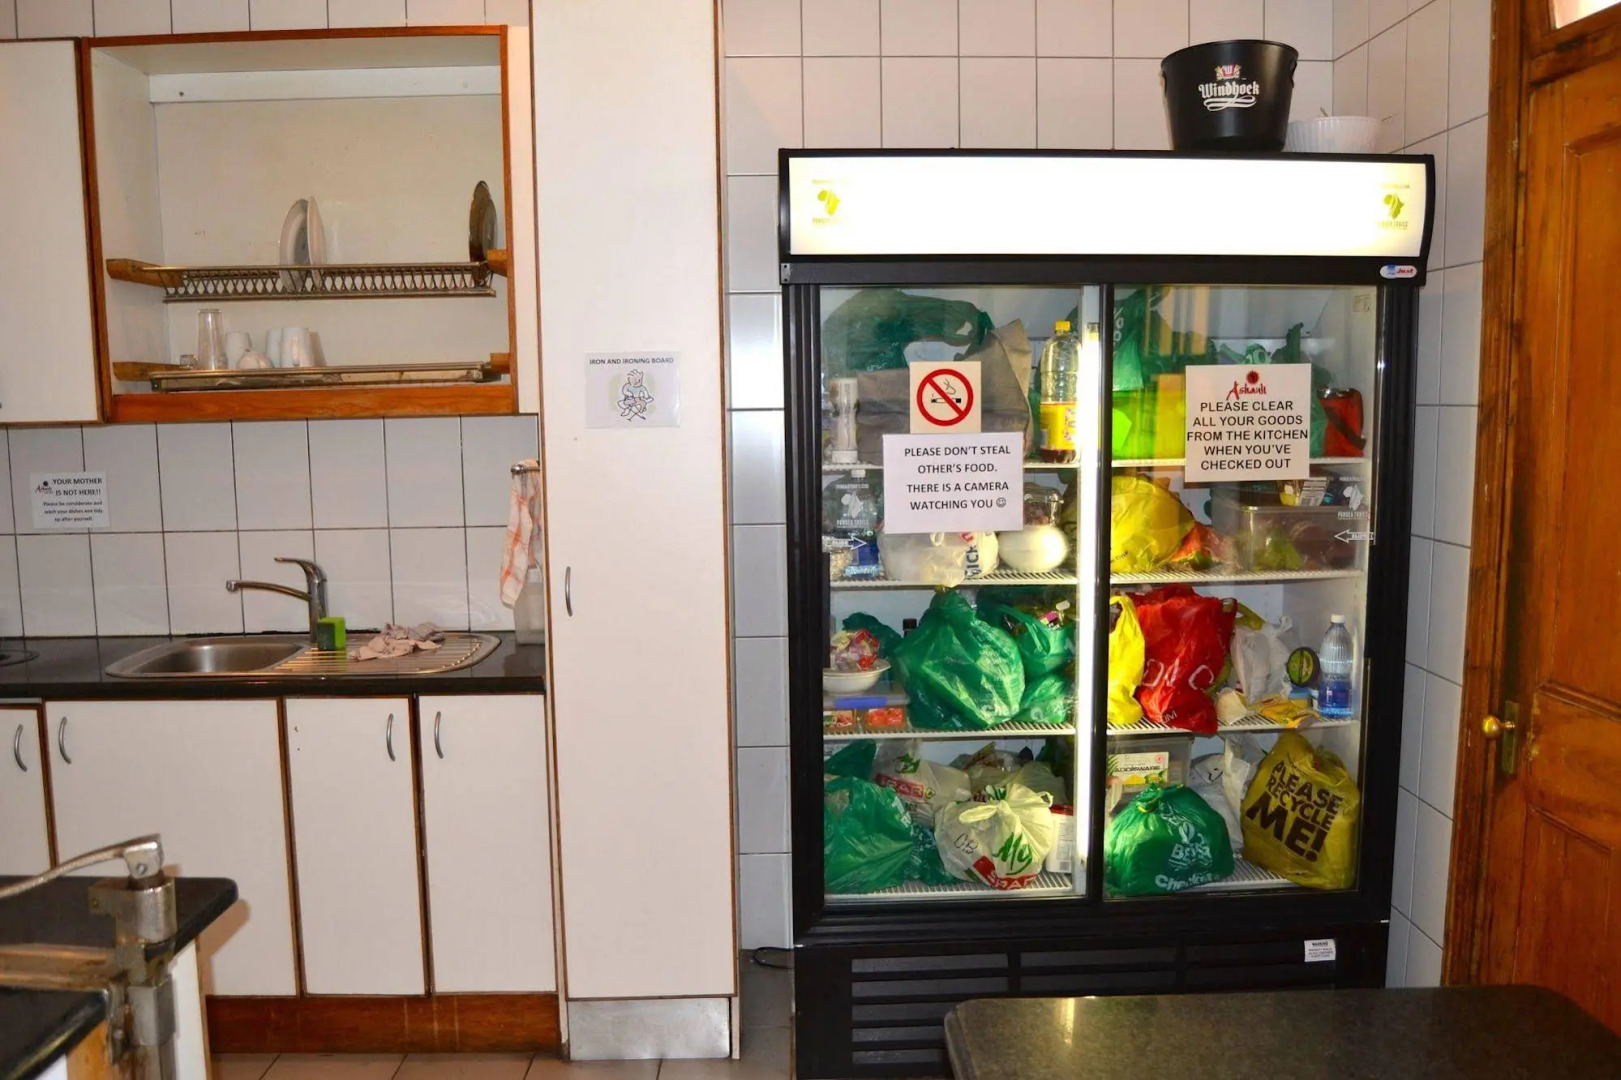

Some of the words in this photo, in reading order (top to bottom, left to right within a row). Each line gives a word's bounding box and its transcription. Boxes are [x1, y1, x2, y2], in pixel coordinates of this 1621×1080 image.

[1198, 81, 1260, 99] Windhoek
[1226, 380, 1267, 401] Ashanti
[1200, 401, 1249, 412] PLEASE
[1252, 400, 1293, 411] CLEAR
[1192, 417, 1217, 427] ALL
[1219, 415, 1255, 426] YOUR
[1258, 415, 1303, 425] GOODS
[1187, 431, 1223, 442] FROM
[1226, 430, 1251, 440] THE
[1254, 429, 1308, 440] KITCHEN
[904, 447, 941, 457] PLEASE
[944, 446, 978, 456] DON'T
[980, 445, 1011, 455] STEAL
[1204, 445, 1242, 456] WHEN
[1245, 444, 1292, 455] YOU'VE
[917, 464, 962, 474] OTHER'S
[964, 463, 998, 473] FOOD.
[1200, 459, 1262, 471] CHECKED
[1265, 458, 1292, 469] OUT
[907, 483, 939, 493] THERE
[942, 483, 951, 492] IS
[954, 483, 961, 491] A
[964, 481, 1009, 492] CAMERA
[910, 500, 968, 510] WATCHING
[970, 499, 993, 508] YOU
[1271, 760, 1345, 815] PLEASE
[1265, 774, 1337, 831] RECYCLE
[1245, 790, 1329, 862] ME!
